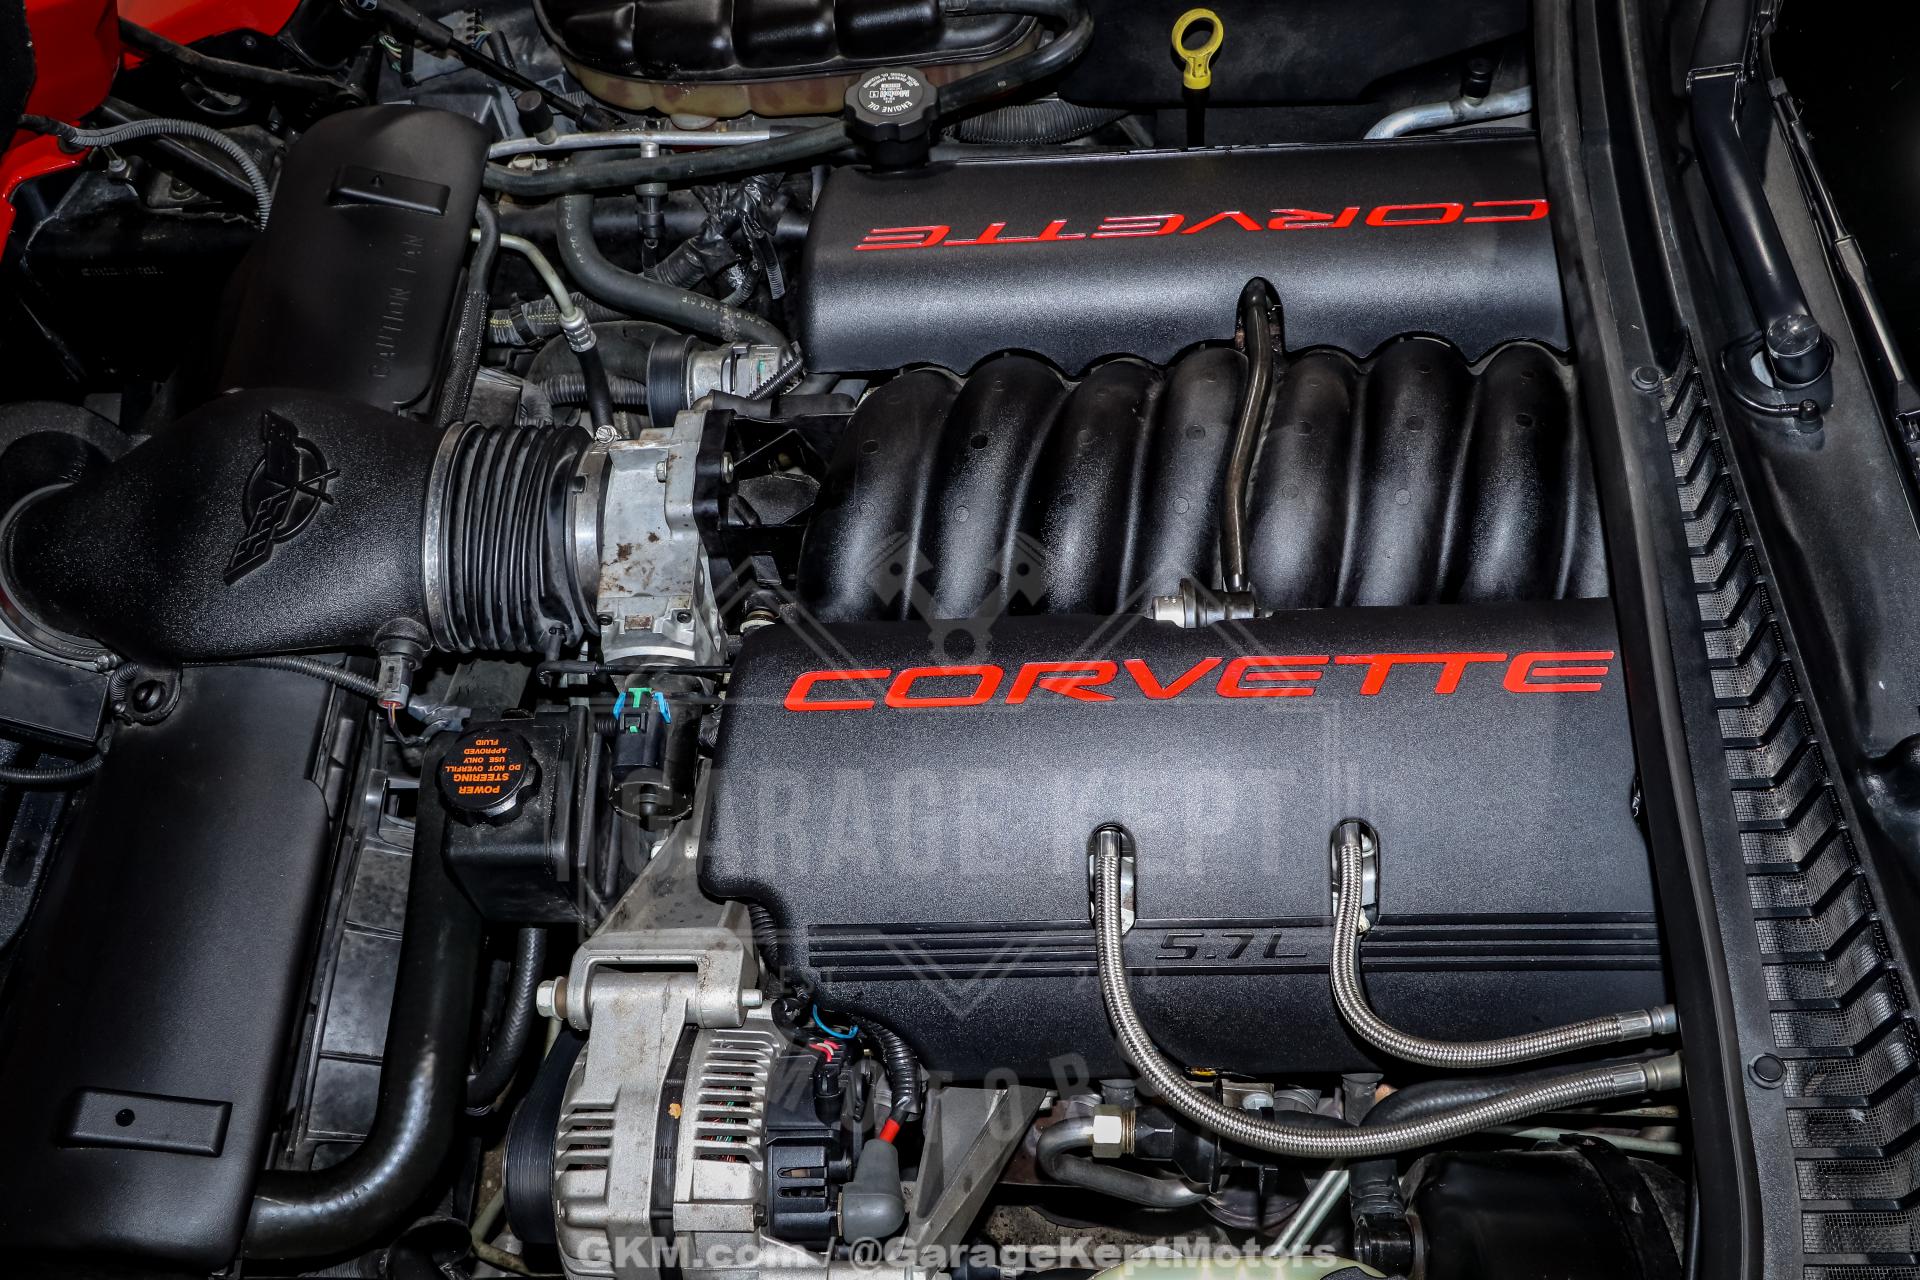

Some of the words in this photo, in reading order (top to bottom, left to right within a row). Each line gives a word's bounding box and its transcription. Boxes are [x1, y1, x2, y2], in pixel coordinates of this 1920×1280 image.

[867, 101, 880, 111] OIL
[882, 101, 913, 113] ENGINE
[854, 198, 1550, 251] CORVETTE
[369, 287, 412, 379] CAUTION
[783, 649, 1613, 712] CORVETTE
[453, 773, 509, 782] STEERING
[458, 786, 500, 794] POWER
[1155, 932, 1308, 960] 5.7L
